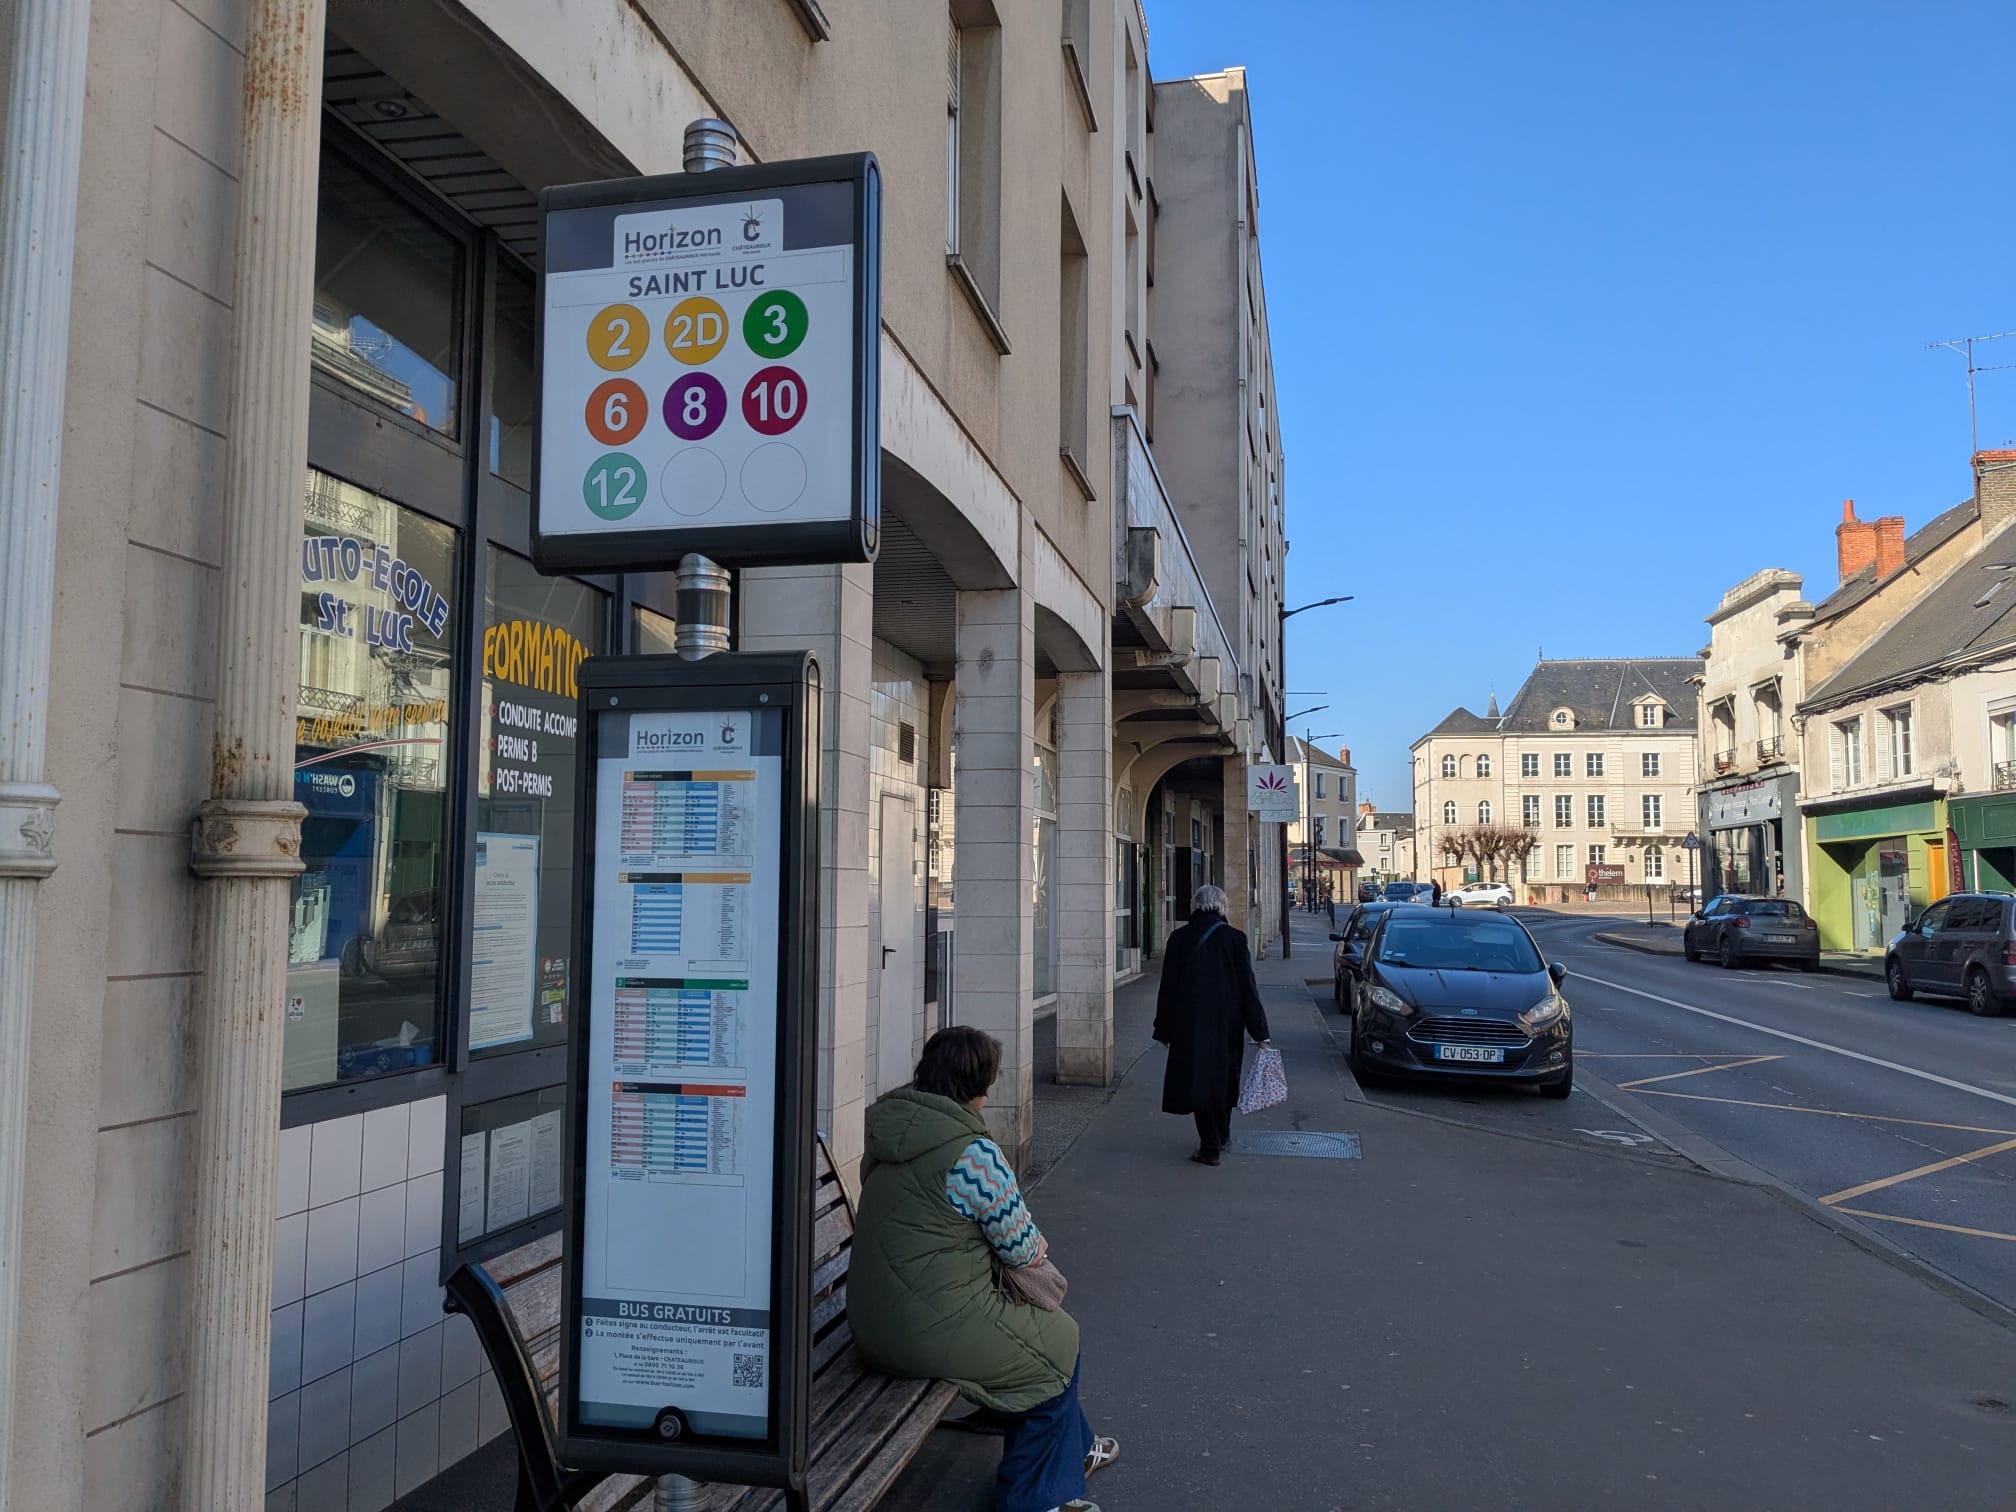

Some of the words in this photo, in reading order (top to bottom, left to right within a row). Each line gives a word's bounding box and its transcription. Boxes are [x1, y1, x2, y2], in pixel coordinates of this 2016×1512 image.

[625, 225, 722, 253] Horizon
[629, 270, 707, 298] SAINT
[715, 264, 765, 290] LUC
[606, 318, 631, 358] 2
[671, 312, 723, 349] 2D
[763, 304, 788, 345] 3
[604, 392, 628, 431] 6
[682, 386, 707, 426] 8
[750, 379, 798, 422] 10
[591, 466, 637, 507] 12
[318, 591, 353, 637] St.
[365, 602, 414, 654] LUC
[482, 620, 594, 700] FORMATIO
[499, 701, 541, 732] CONDUITE
[497, 734, 529, 762] PERMIS
[531, 740, 537, 763] B
[637, 728, 704, 746] Horizon
[496, 767, 552, 797] POST-PERMIS
[596, 1319, 617, 1327] Faites
[619, 1320, 638, 1329] signe
[649, 1323, 692, 1334] conducteur,
[693, 1325, 716, 1335] l'arrêt
[717, 1328, 729, 1336] est
[731, 1328, 765, 1338] facultatif
[619, 1302, 649, 1318] BUS
[653, 1305, 731, 1324] GRATUITS
[606, 1330, 634, 1340] montée
[636, 1332, 674, 1343] s'effectue
[675, 1336, 721, 1346] uniquement
[723, 1340, 736, 1348] par
[737, 1339, 765, 1350] l'avant
